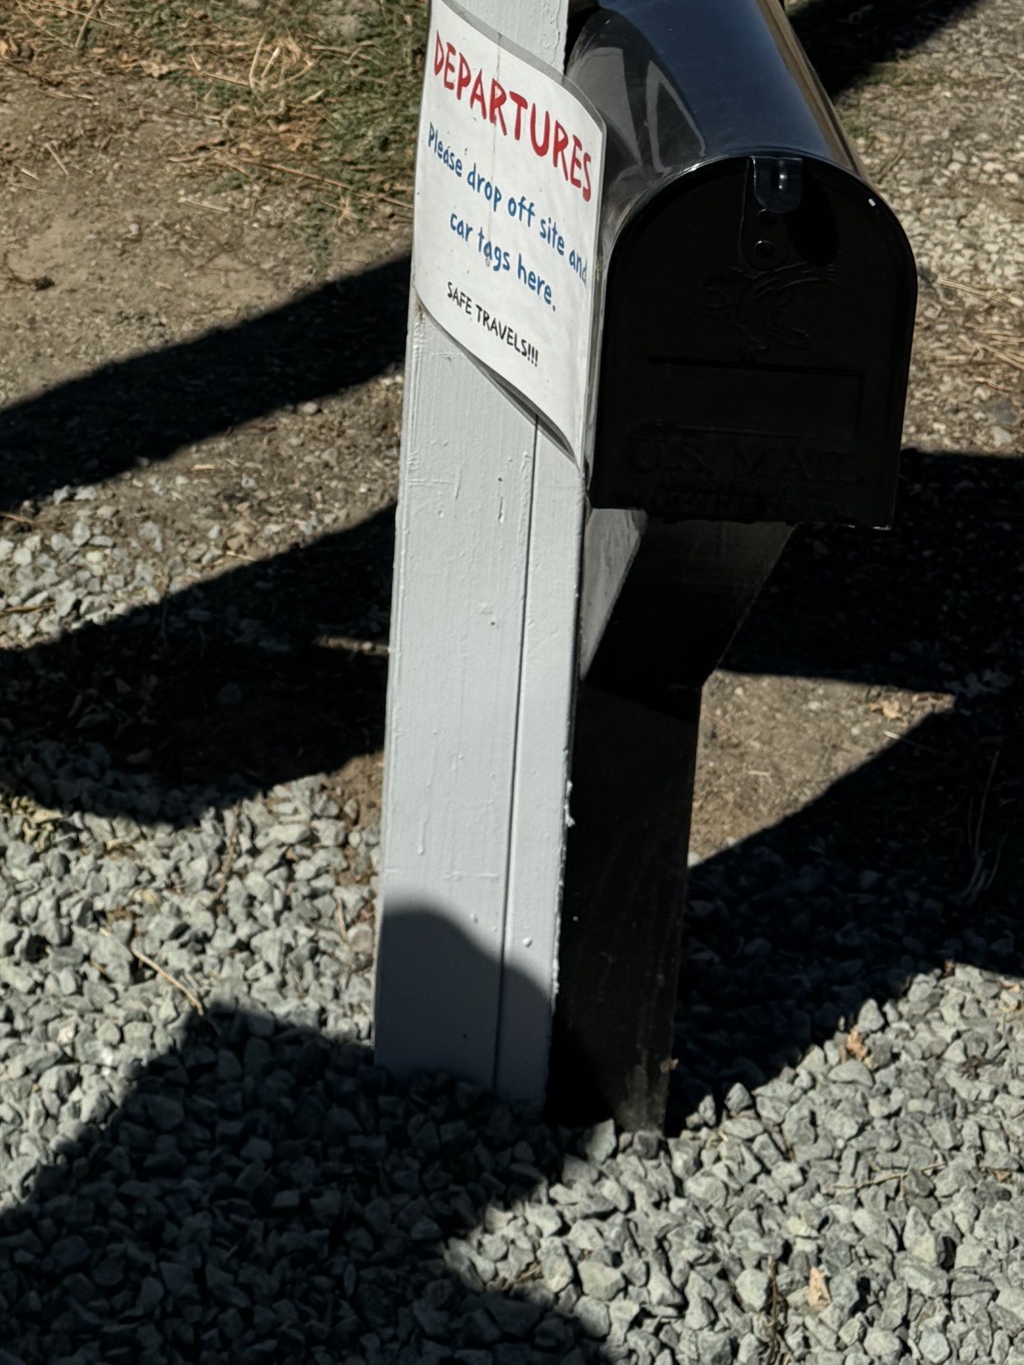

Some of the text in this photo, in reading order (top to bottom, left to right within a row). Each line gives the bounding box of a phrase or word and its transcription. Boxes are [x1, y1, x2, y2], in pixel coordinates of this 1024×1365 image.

[434, 31, 592, 202] DEPARTURES
[429, 122, 588, 284] Please drop off site and
[450, 212, 556, 312] car tags here.
[447, 282, 539, 367] SAFE TRAVELS!!!
